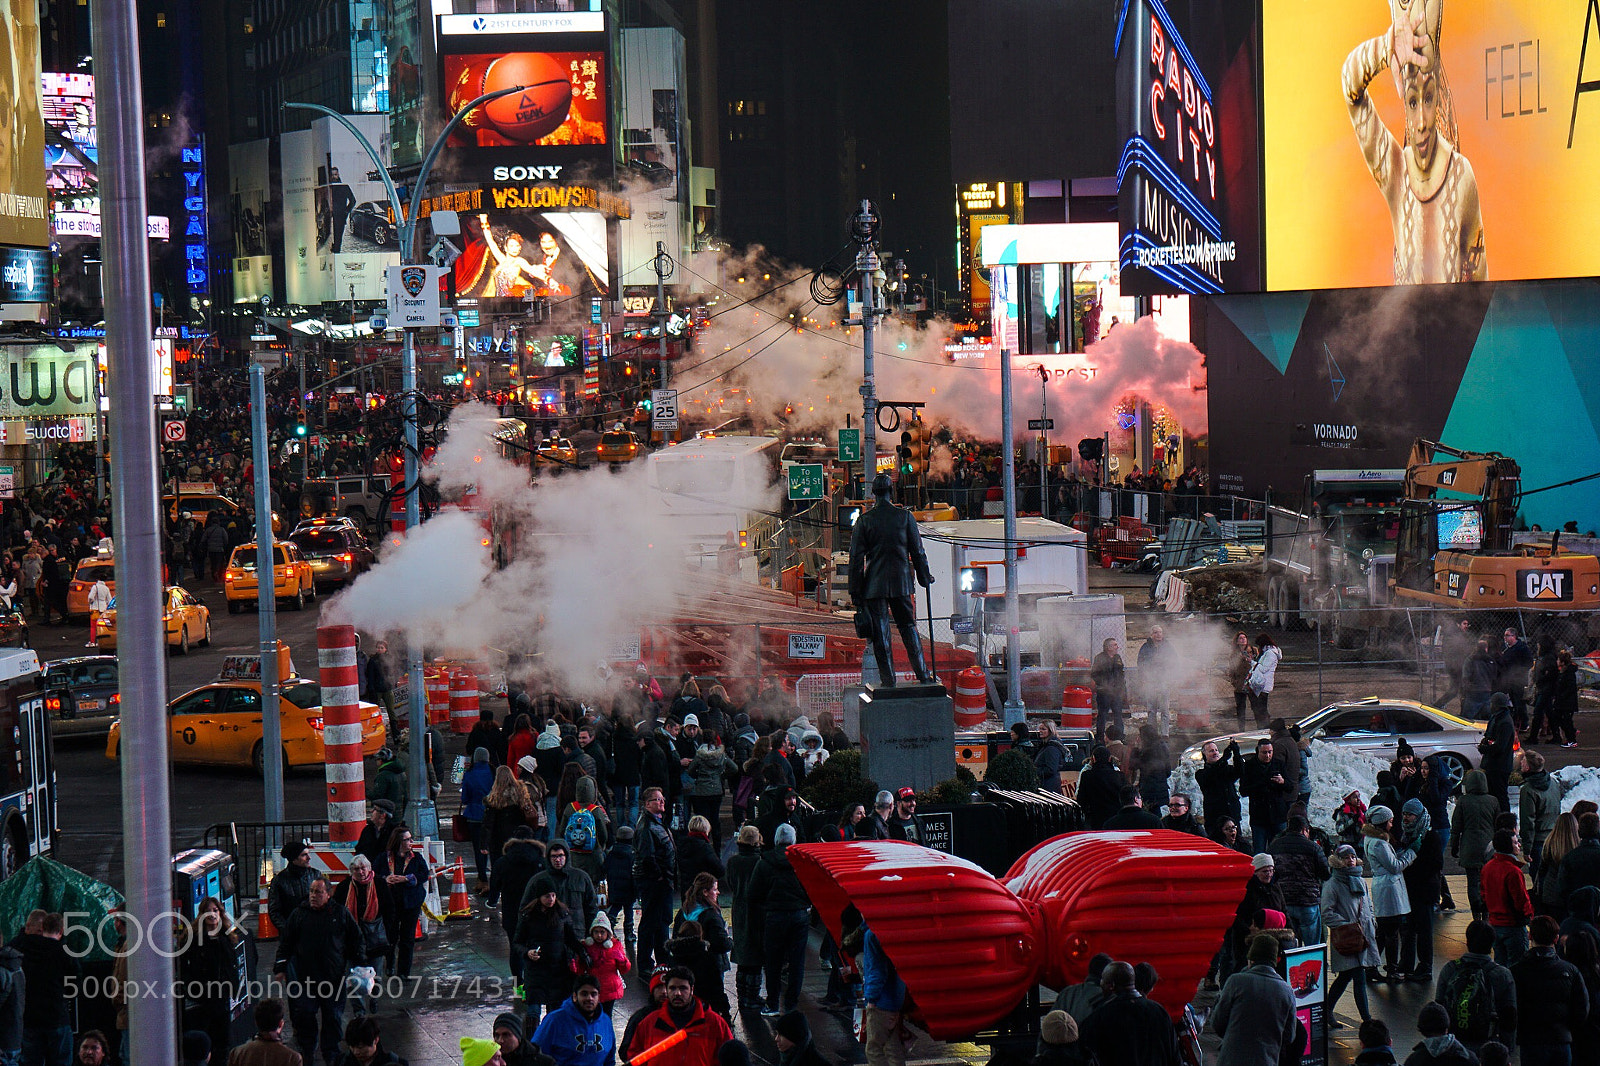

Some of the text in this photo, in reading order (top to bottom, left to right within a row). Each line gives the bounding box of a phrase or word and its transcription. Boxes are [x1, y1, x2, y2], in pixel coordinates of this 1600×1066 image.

[490, 20, 511, 28] 21ST
[555, 19, 573, 27] FOX
[1152, 14, 1214, 147] RADIO
[1485, 39, 1547, 120] FEEL
[515, 107, 546, 122] PEAK
[1151, 79, 1215, 200] CITY
[493, 165, 562, 181] SONY
[970, 183, 987, 192] GET
[963, 191, 996, 200] TICKETS
[56, 218, 75, 231] the
[1145, 179, 1192, 256] MUSIC
[656, 406, 675, 418] 25
[24, 424, 76, 440] swatch
[1313, 423, 1358, 440] VORNADO
[790, 477, 821, 486] W 45 St
[1443, 471, 1453, 484] CAT
[1449, 573, 1460, 588] CAT
[1526, 573, 1565, 599] CAT
[791, 635, 824, 643] PEDESTRIAN
[795, 642, 821, 650] WALKWAY
[926, 822, 945, 831] MES
